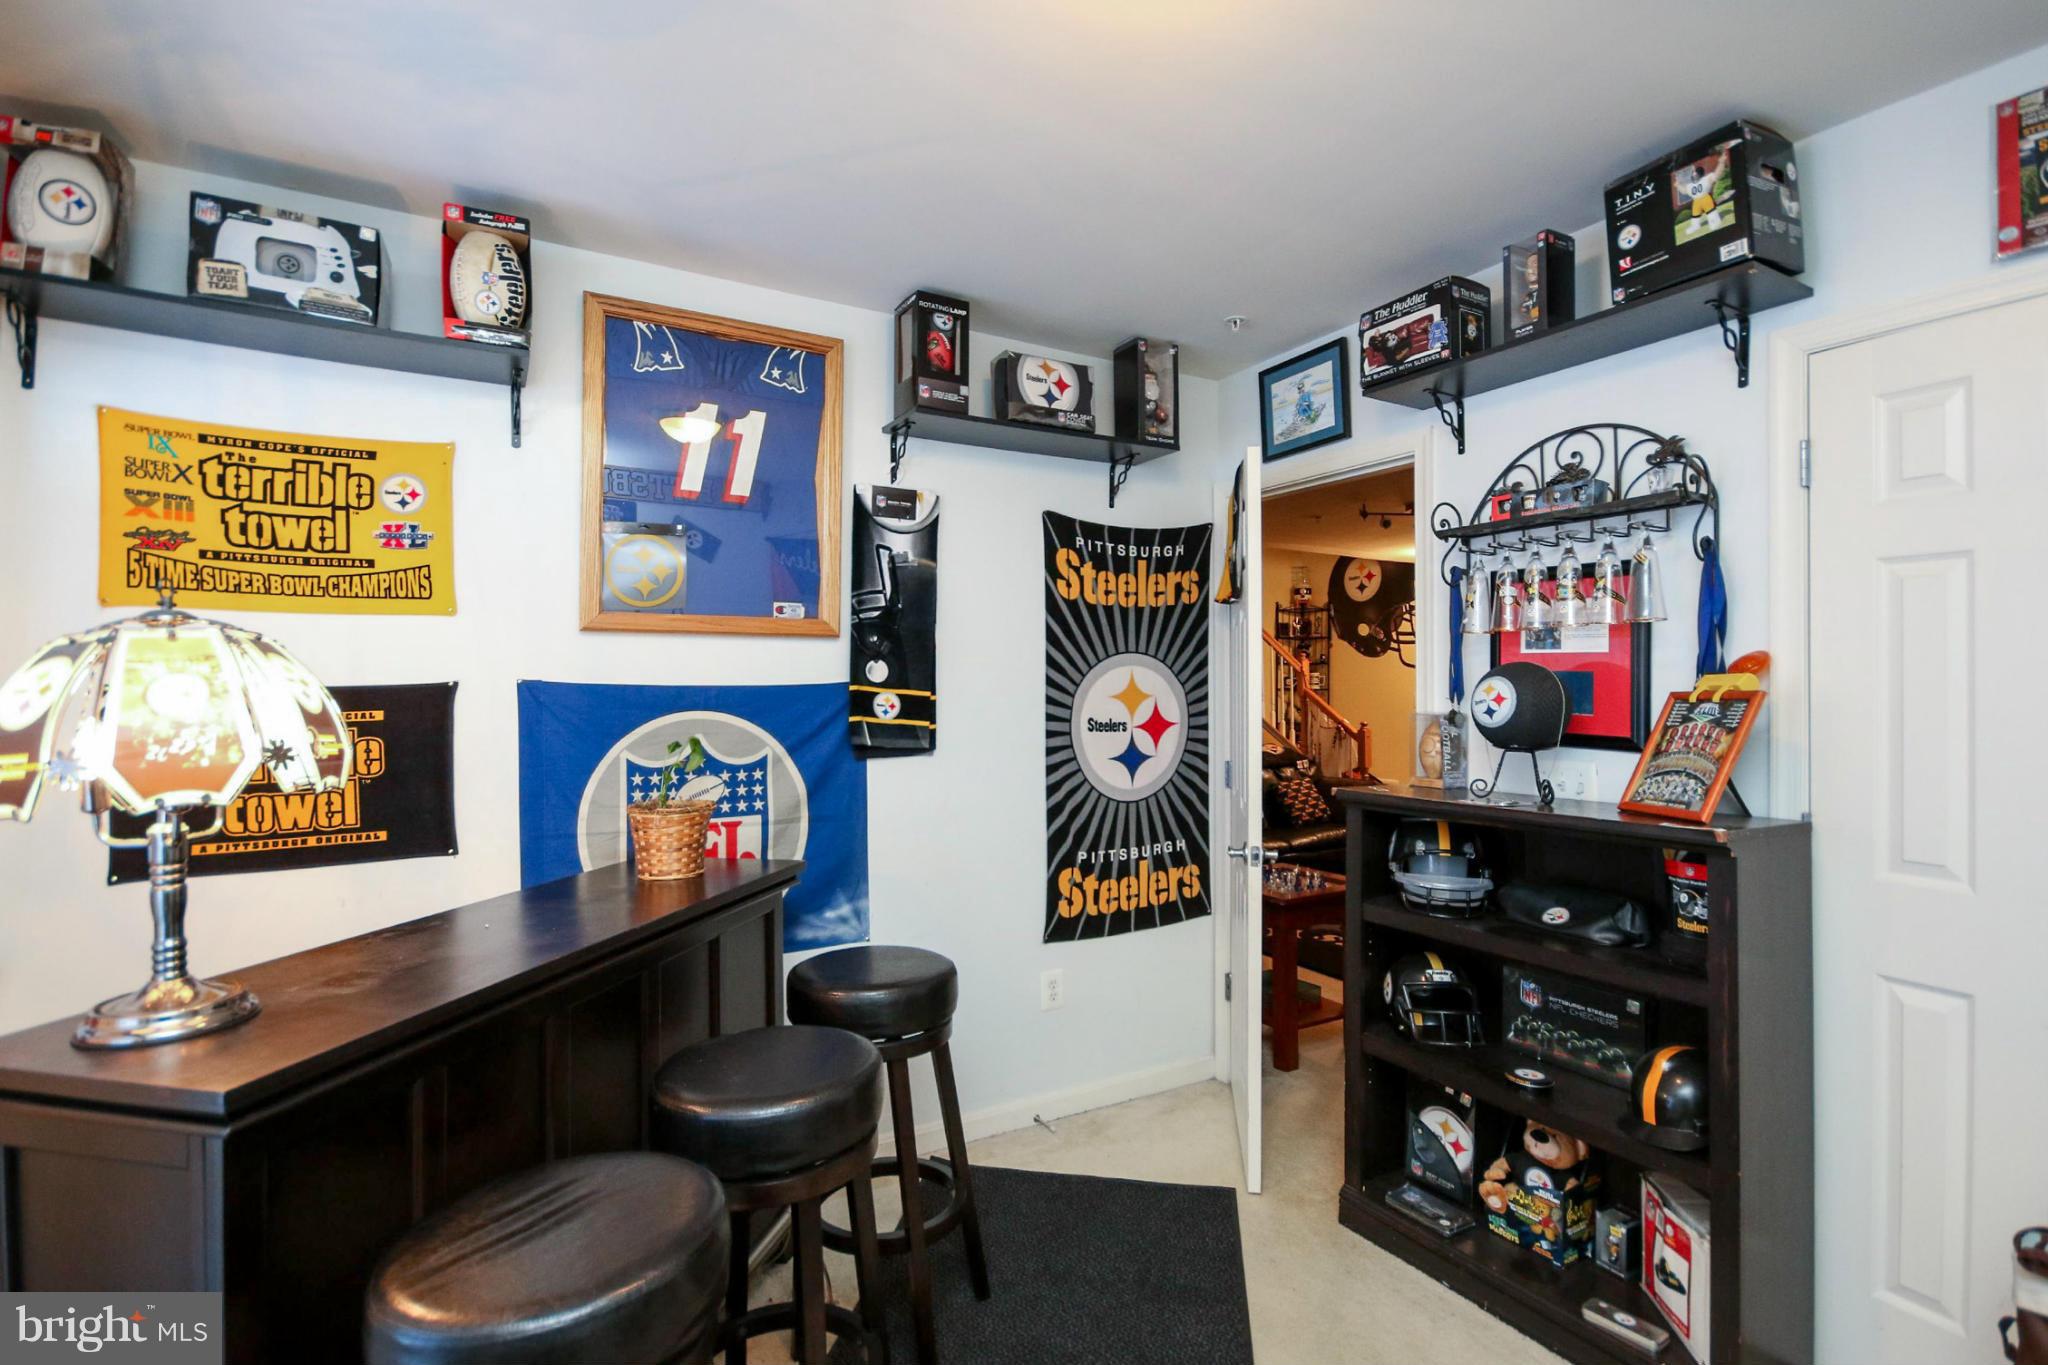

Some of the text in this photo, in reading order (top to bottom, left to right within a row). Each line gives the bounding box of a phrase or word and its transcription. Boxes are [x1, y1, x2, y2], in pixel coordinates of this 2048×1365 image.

[1615, 183, 1655, 207] TINY
[1691, 183, 1703, 196] 00
[208, 275, 238, 283] YOUR
[208, 282, 239, 291] TEAM
[918, 300, 949, 312] ROTATING
[949, 307, 967, 316] LAMP
[1375, 308, 1390, 320] The
[1392, 292, 1428, 314] Huddler
[1026, 373, 1048, 384] Steelers
[1362, 353, 1440, 383] THE BLANKET WITH SLEEVES
[123, 423, 195, 441] SUPER BOWL
[148, 433, 178, 458] IX
[207, 436, 369, 458] MYRON COPE'S OFFICIAL
[672, 402, 767, 506] 11
[124, 456, 171, 472] SUPER
[225, 452, 257, 463] The
[124, 464, 194, 485] BOWL X
[198, 453, 375, 511] terrible
[124, 488, 194, 502] SUPER BOWL
[220, 501, 350, 553] towel
[381, 524, 428, 549] XL
[1075, 536, 1185, 558] PITTSBURGH
[205, 551, 369, 567] A PITTSBURGH ORIGINAL
[127, 548, 432, 600] 5 TIME SUPER BOWL CHAMPIONS
[1055, 548, 1200, 608] Steelers
[1087, 717, 1128, 732] Steelers
[216, 838, 308, 852] PITTSBURGH
[315, 831, 381, 843] ORIGINAL
[1077, 839, 1186, 864] PITTSBURGH
[1057, 859, 1201, 918] Steelers
[1524, 991, 1542, 1006] NFL
[1549, 996, 1618, 1020] PITTSBURGH STEELERS
[1569, 1008, 1619, 1029] CHECKERS
